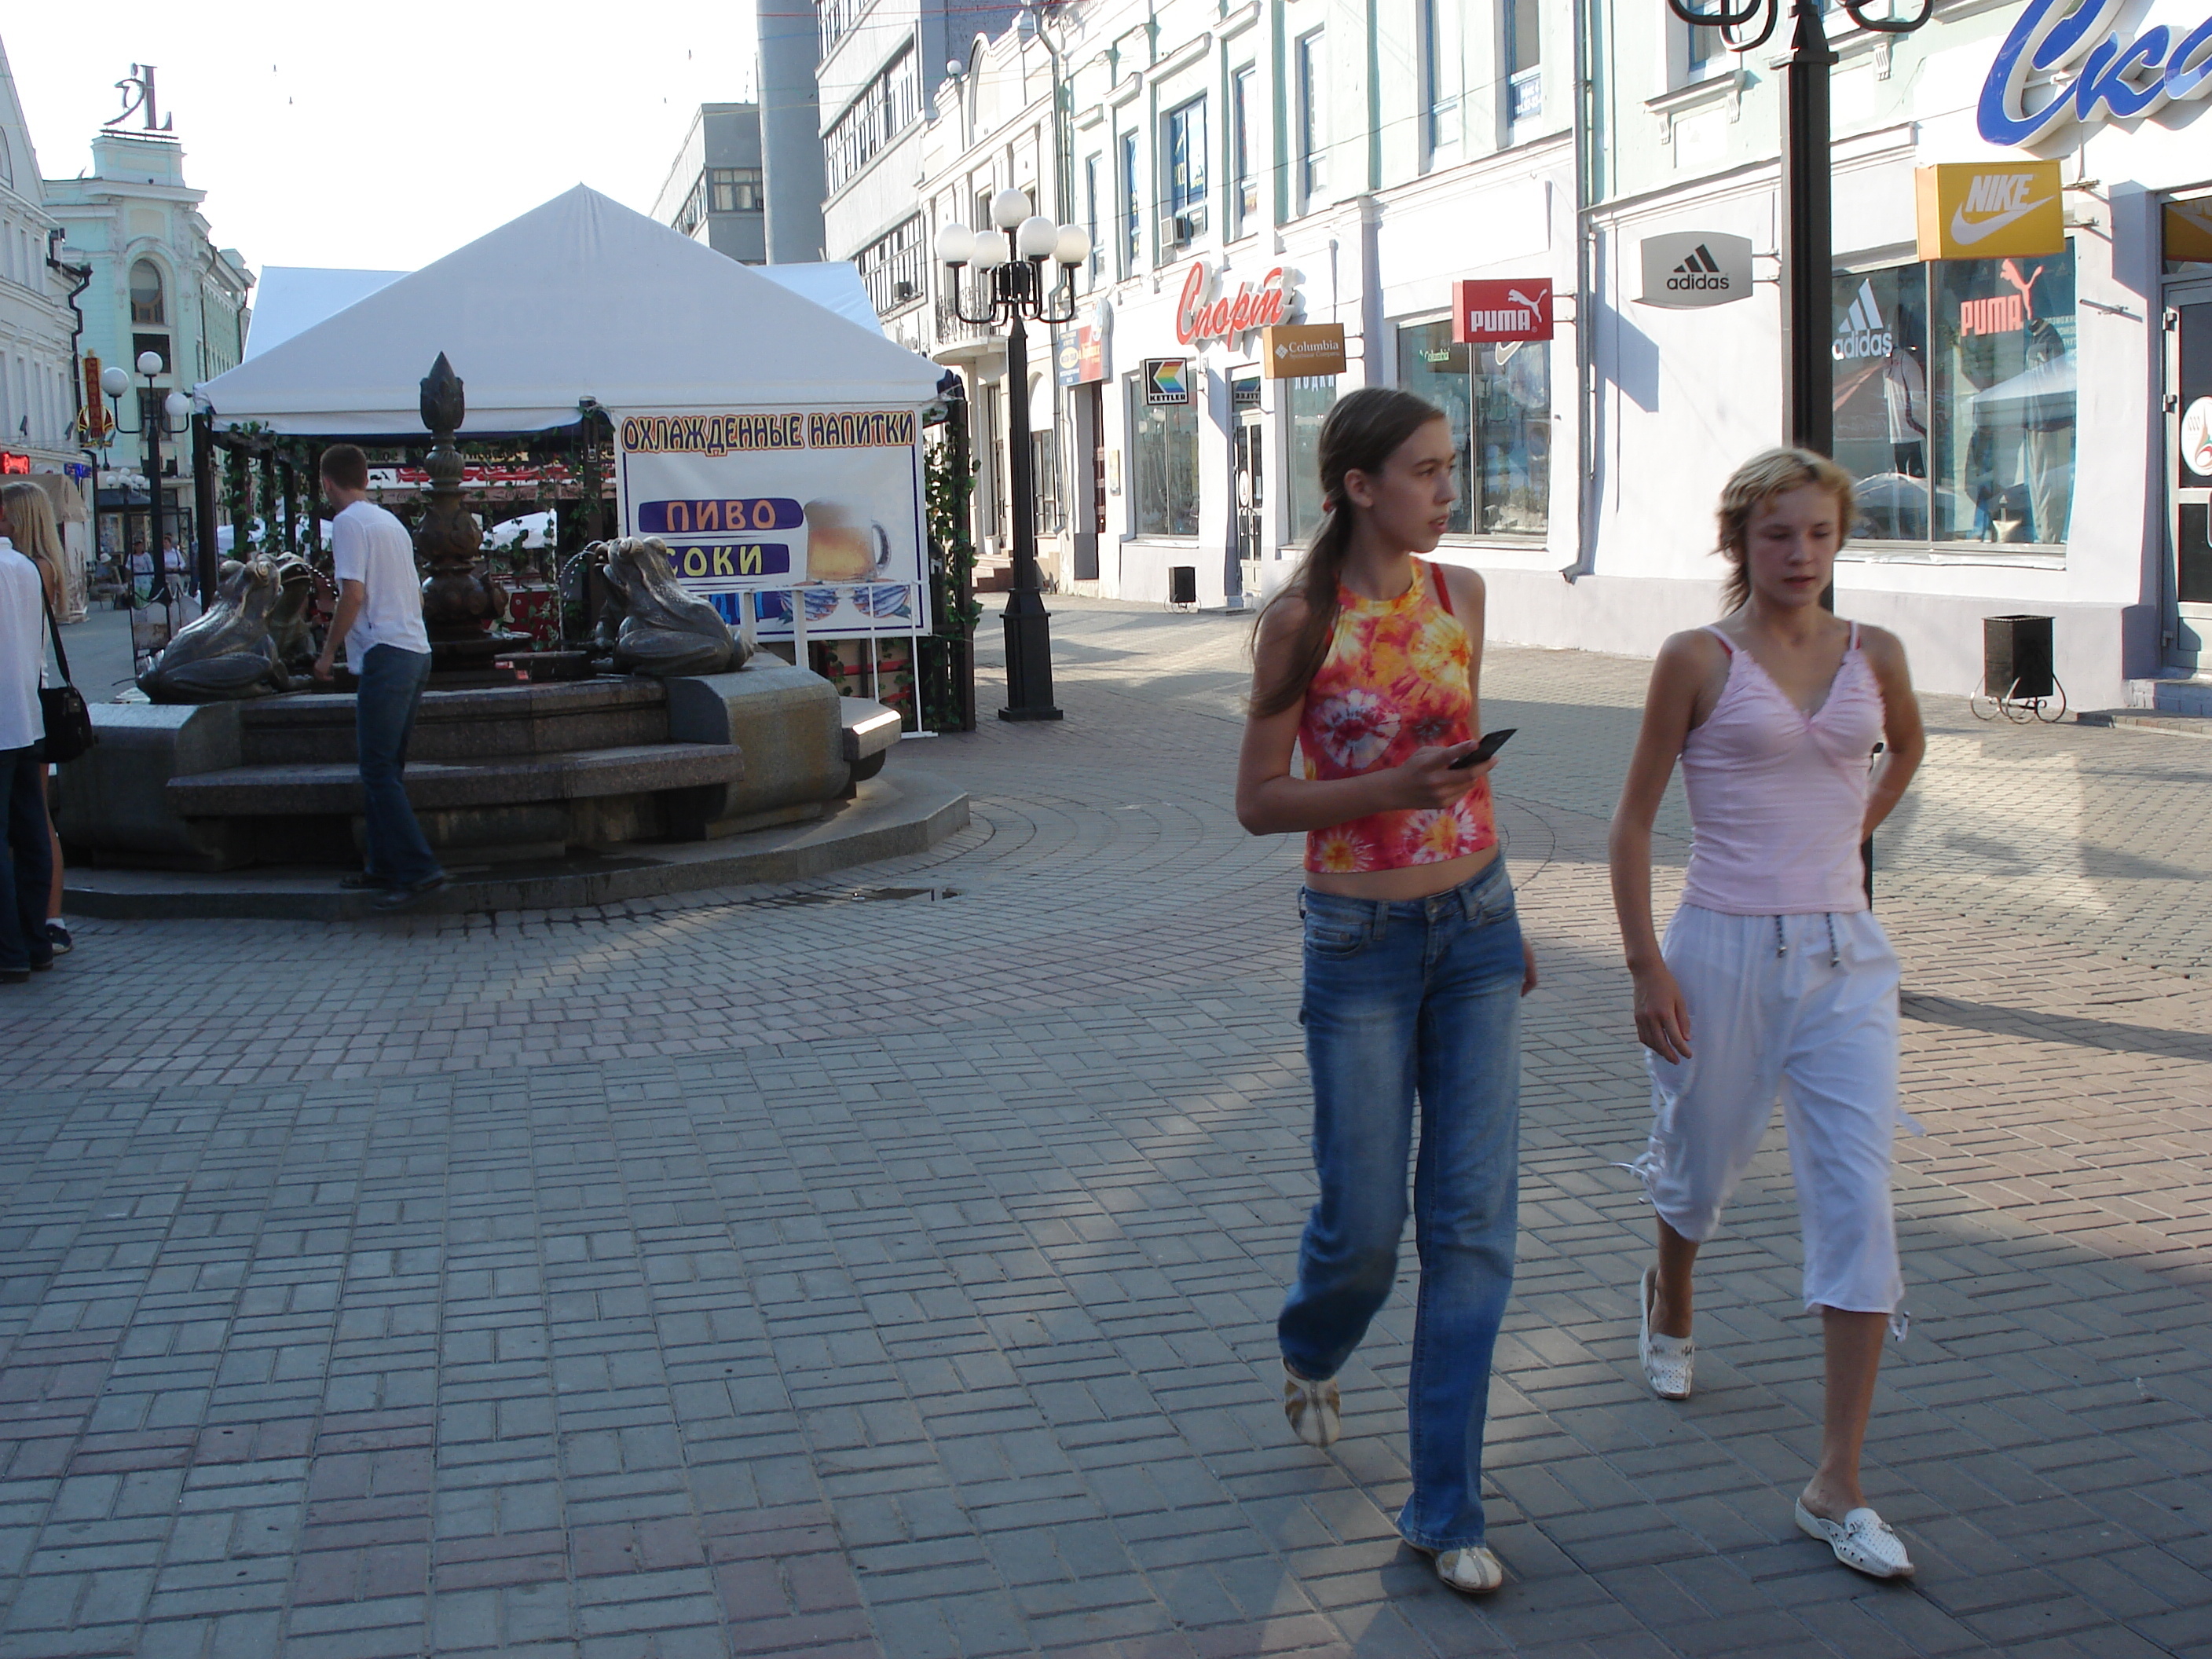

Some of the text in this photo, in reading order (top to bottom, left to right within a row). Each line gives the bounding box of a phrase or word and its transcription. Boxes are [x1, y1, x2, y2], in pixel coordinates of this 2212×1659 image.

[1965, 174, 2034, 212] NIKE
[1666, 273, 1730, 290] adidas
[1177, 262, 1284, 352] Спорт
[1470, 309, 1530, 332] PUMA
[1961, 295, 2022, 337] PUMA
[1288, 339, 1339, 353] Columbia
[1832, 328, 1893, 361] adidas
[622, 410, 915, 456] ОХЛАЖДЕННЫЕ НАПИТКИ
[667, 500, 776, 532] ПИВО
